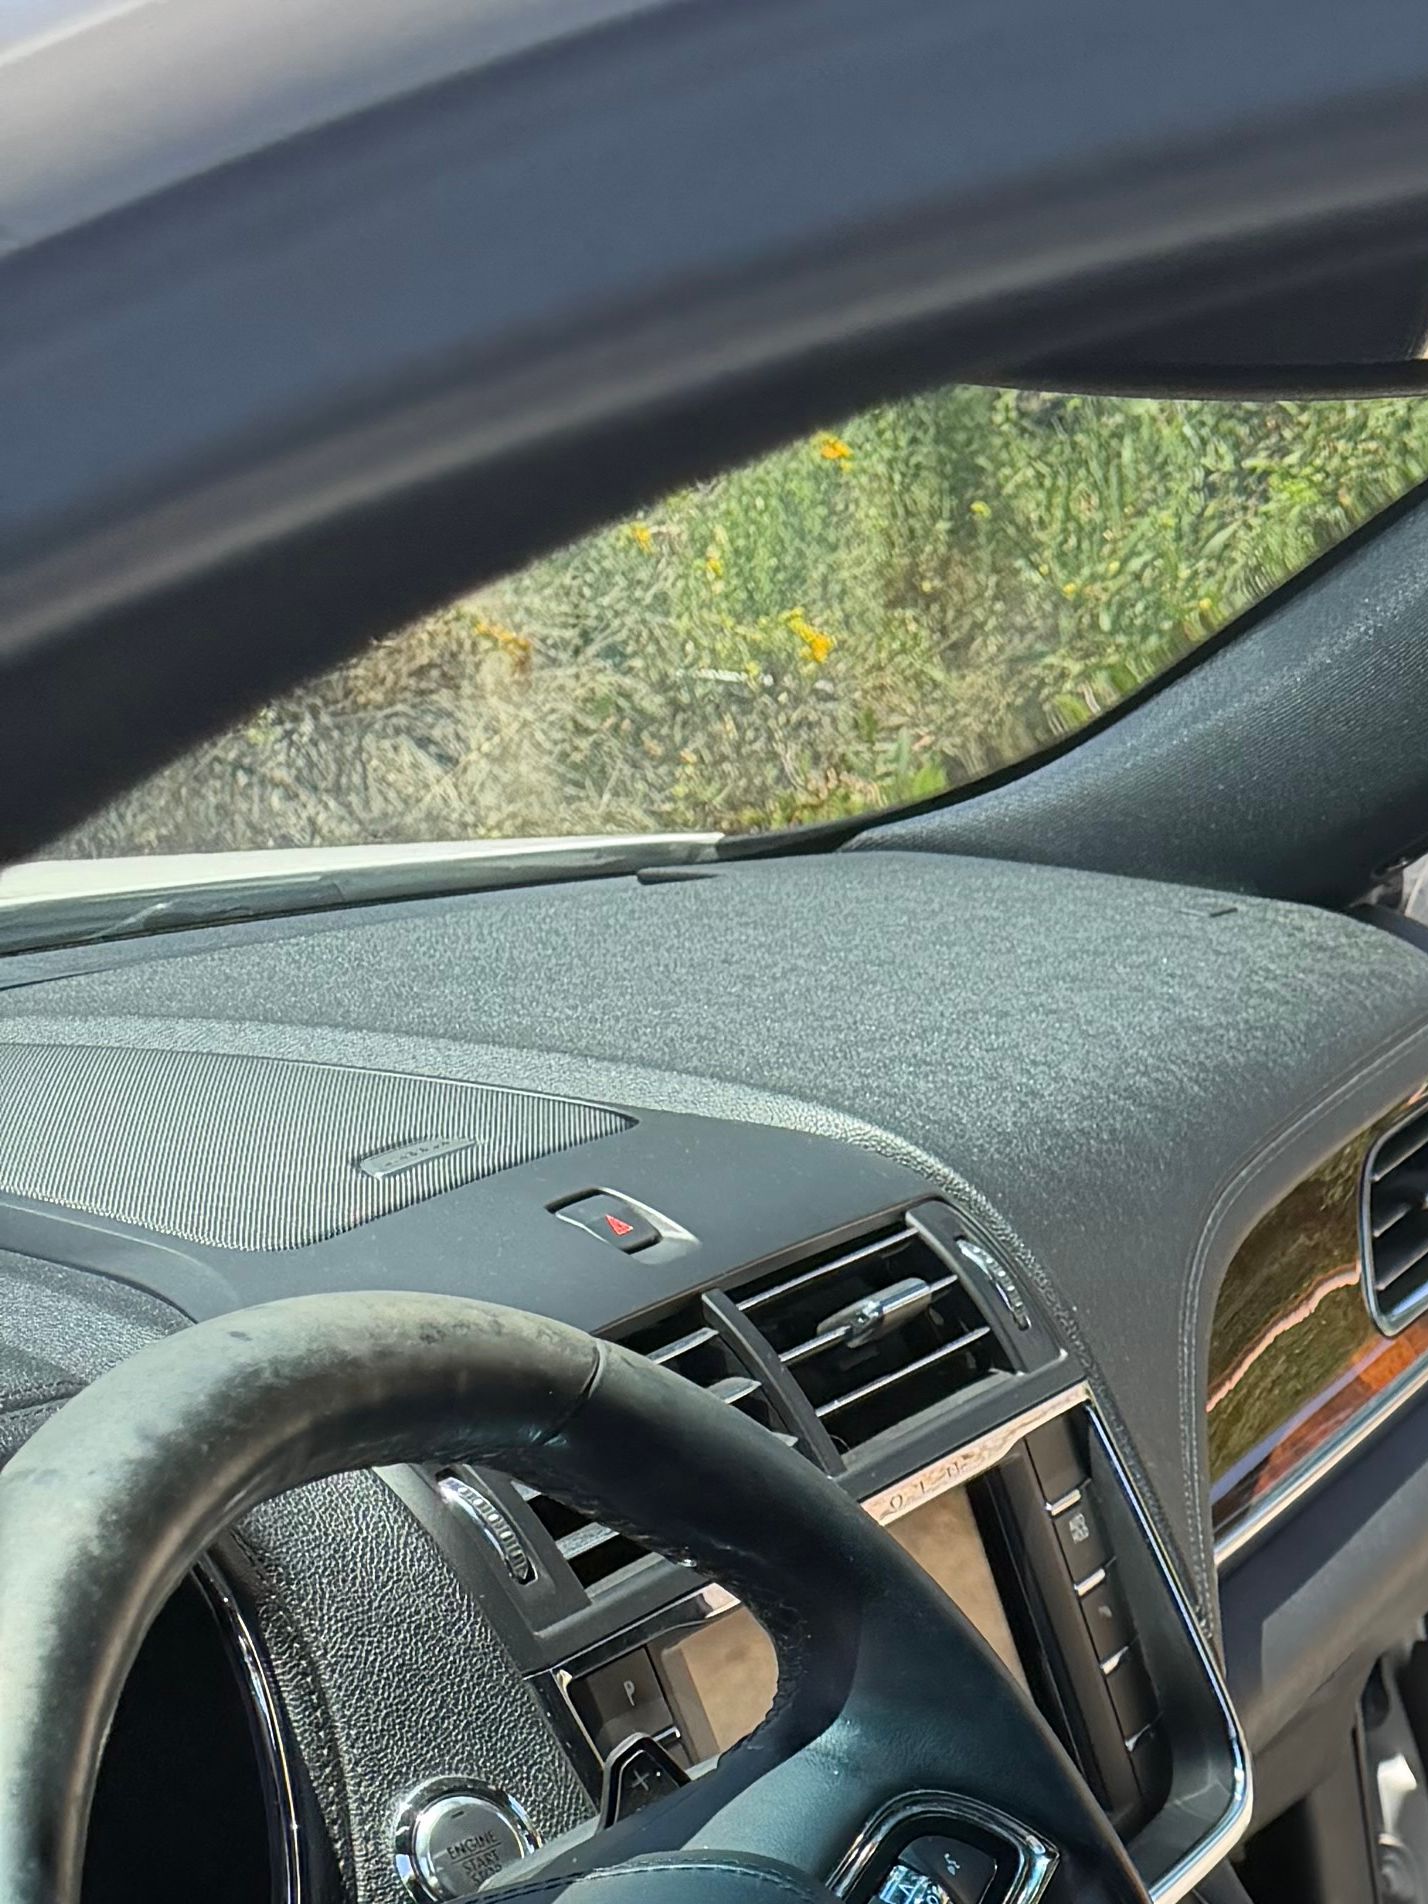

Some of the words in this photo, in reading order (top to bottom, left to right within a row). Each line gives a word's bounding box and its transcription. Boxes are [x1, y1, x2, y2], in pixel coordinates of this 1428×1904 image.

[623, 1680, 636, 1707] P
[446, 1830, 498, 1860] ENGINE
[462, 1849, 502, 1875] START
